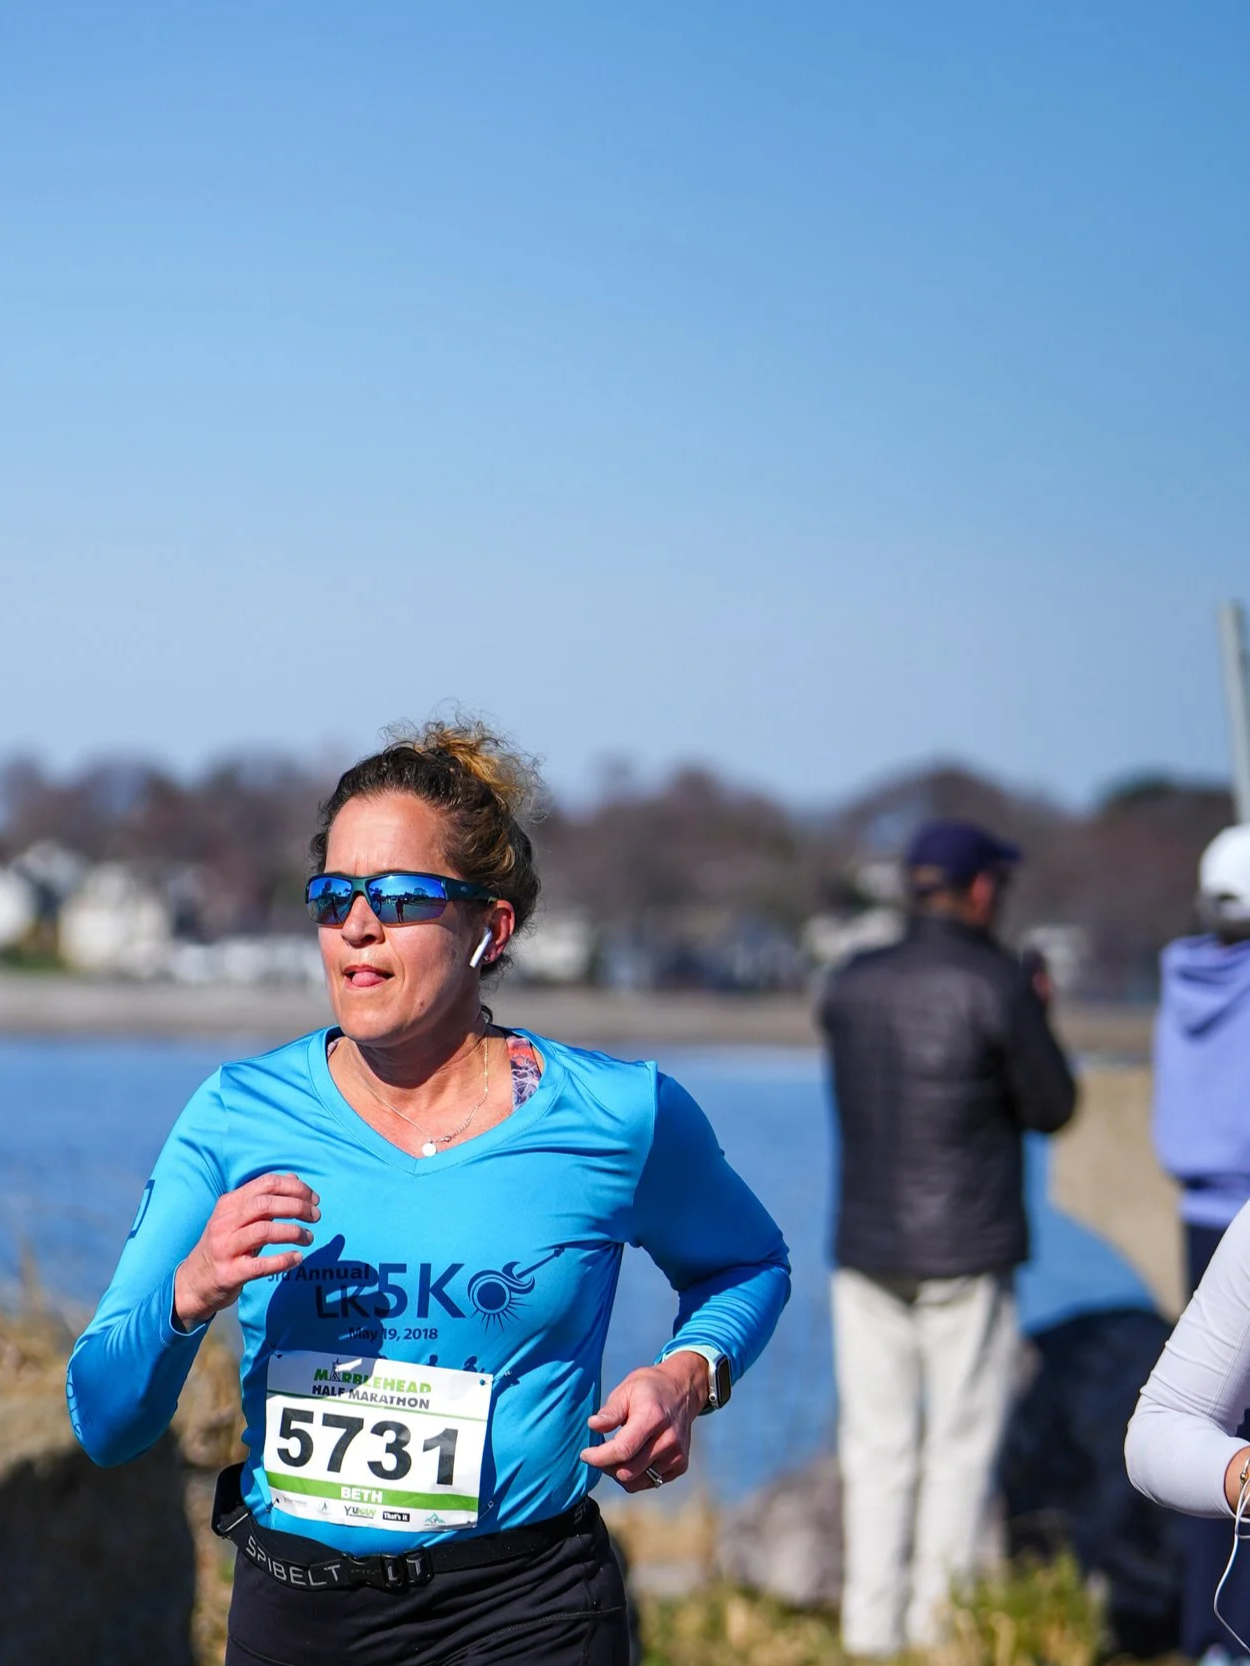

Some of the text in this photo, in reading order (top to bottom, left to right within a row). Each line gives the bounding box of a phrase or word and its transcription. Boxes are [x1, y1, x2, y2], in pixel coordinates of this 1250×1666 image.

[296, 1265, 370, 1281] Annual
[350, 1327, 438, 1342] May 19, 2018
[313, 1366, 432, 1393] MARBLEHEAD
[312, 1385, 430, 1410] HALF MARATHON
[277, 1407, 458, 1486] 5731
[341, 1486, 383, 1504] BETH
[246, 1535, 341, 1586] SPIBELT
